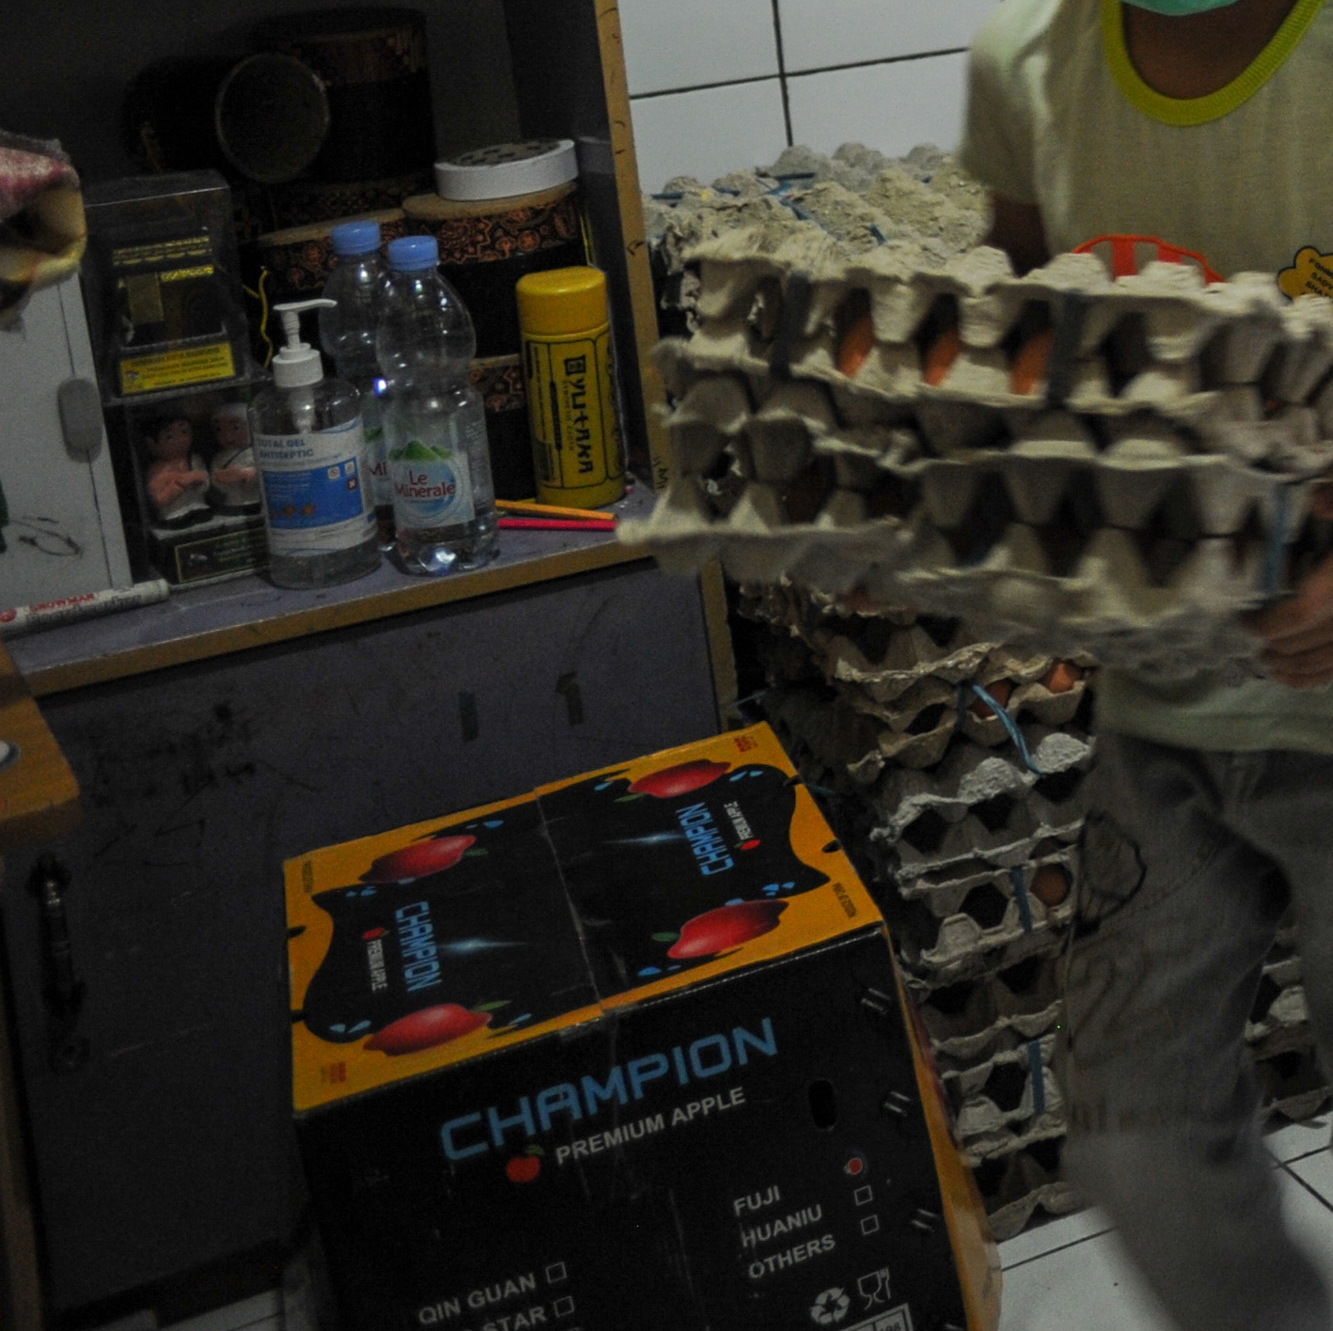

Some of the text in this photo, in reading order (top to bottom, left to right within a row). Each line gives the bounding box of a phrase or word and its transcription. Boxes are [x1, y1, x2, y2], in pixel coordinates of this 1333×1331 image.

[395, 480, 456, 498] Minerale
[409, 471, 427, 486] Le
[675, 802, 735, 876] CHAMPION
[396, 901, 442, 992] CHAMPION
[440, 1017, 778, 1162] CHAMPION
[556, 1087, 746, 1165] PREMIUM APPLE
[733, 1185, 781, 1217] FUJI
[741, 1204, 823, 1247] HUANIU
[748, 1234, 836, 1280] OTHERS
[418, 1272, 537, 1326] QIN GUAN
